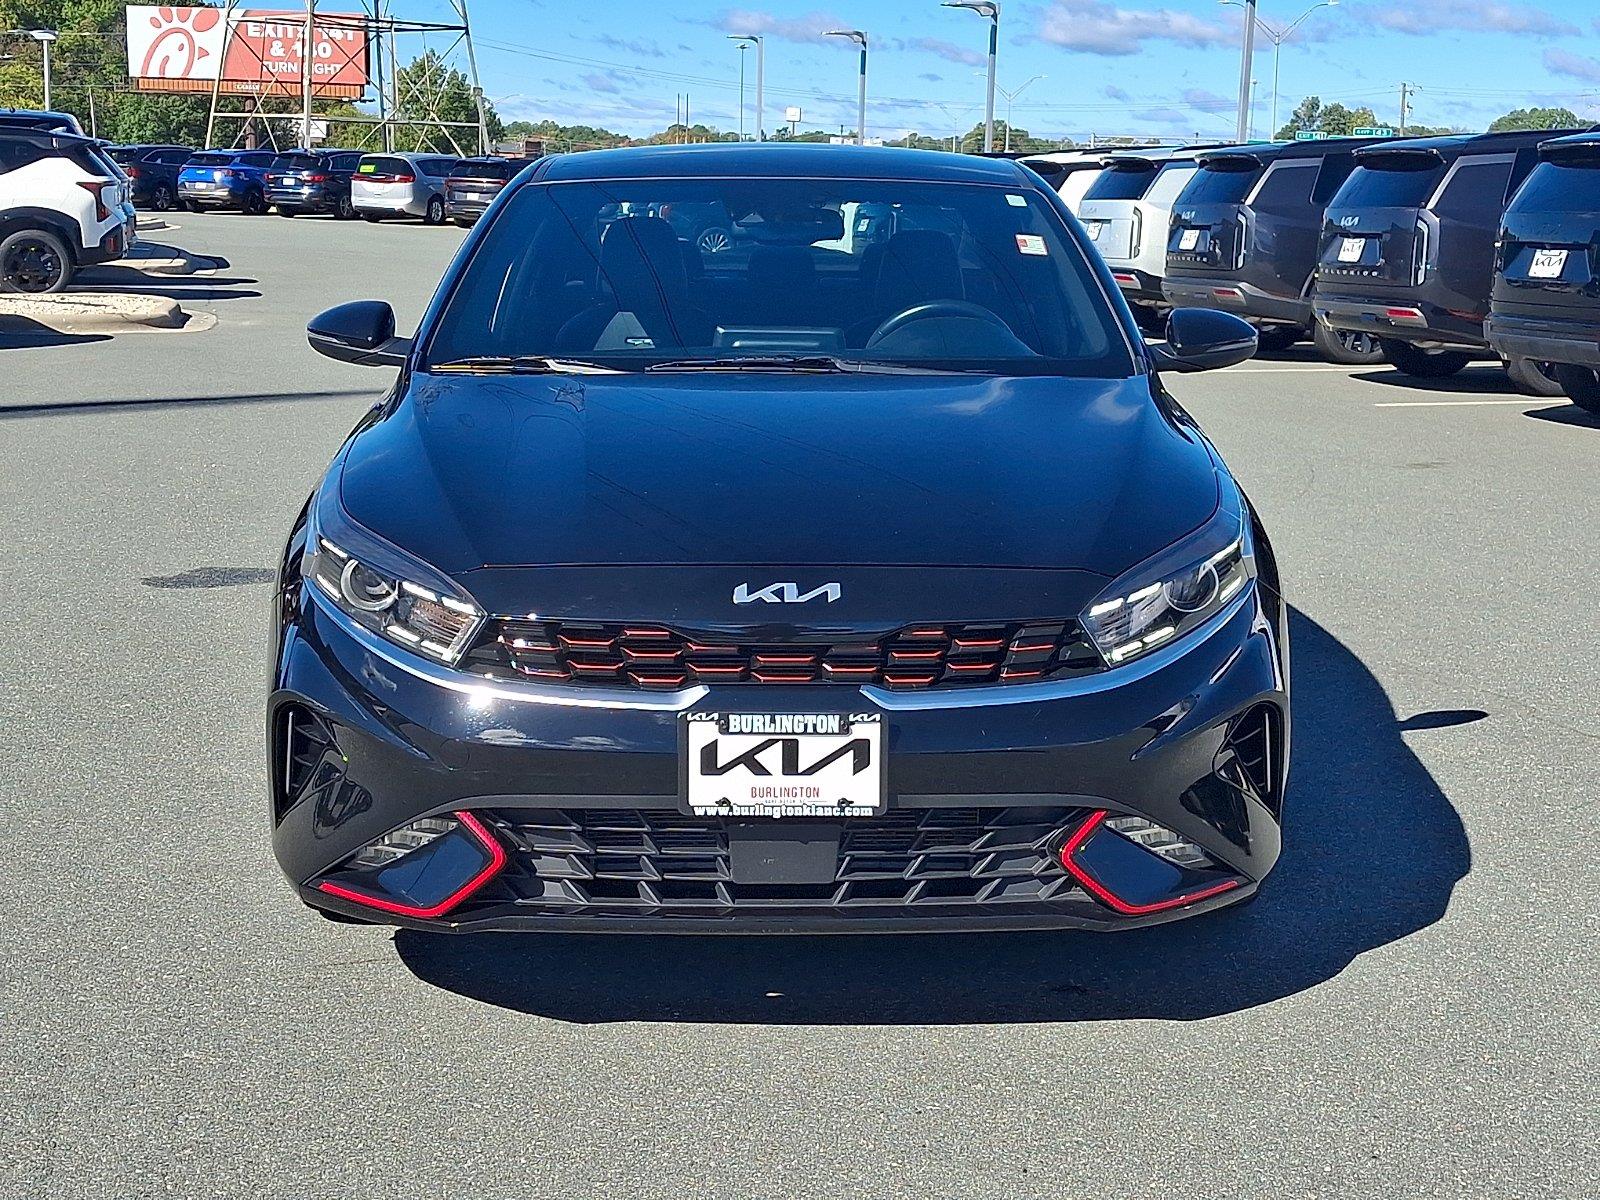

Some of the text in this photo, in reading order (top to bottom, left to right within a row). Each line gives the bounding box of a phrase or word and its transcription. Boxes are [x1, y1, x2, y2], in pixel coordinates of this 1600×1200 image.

[270, 40, 286, 57] &
[1534, 256, 1563, 267] KIA
[733, 582, 841, 604] KIA
[686, 712, 719, 721] KIA
[728, 714, 840, 734] BURLINGTON
[848, 713, 881, 722] KIA
[700, 738, 871, 776] KIA
[751, 786, 820, 798] BURLINGTON
[693, 803, 874, 818] www.burlingtonkianc.com
